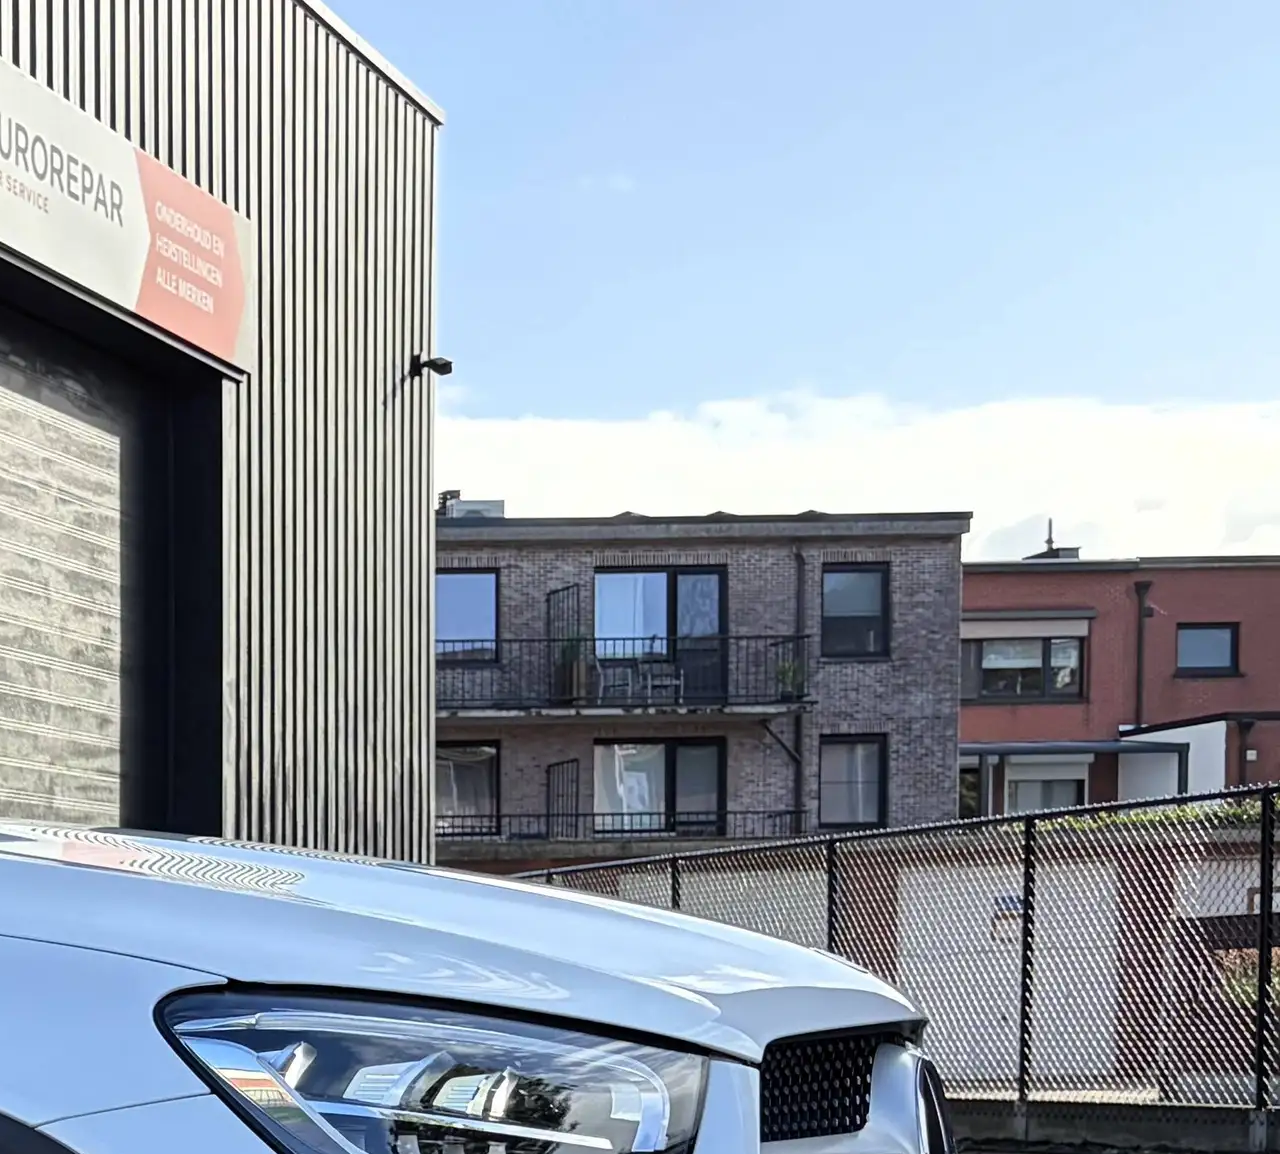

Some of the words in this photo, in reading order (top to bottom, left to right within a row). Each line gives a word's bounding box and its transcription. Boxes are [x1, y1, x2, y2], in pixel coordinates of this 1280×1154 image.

[6, 175, 50, 214] SERVICE
[212, 234, 225, 259] EN
[155, 266, 178, 295] ALLE
